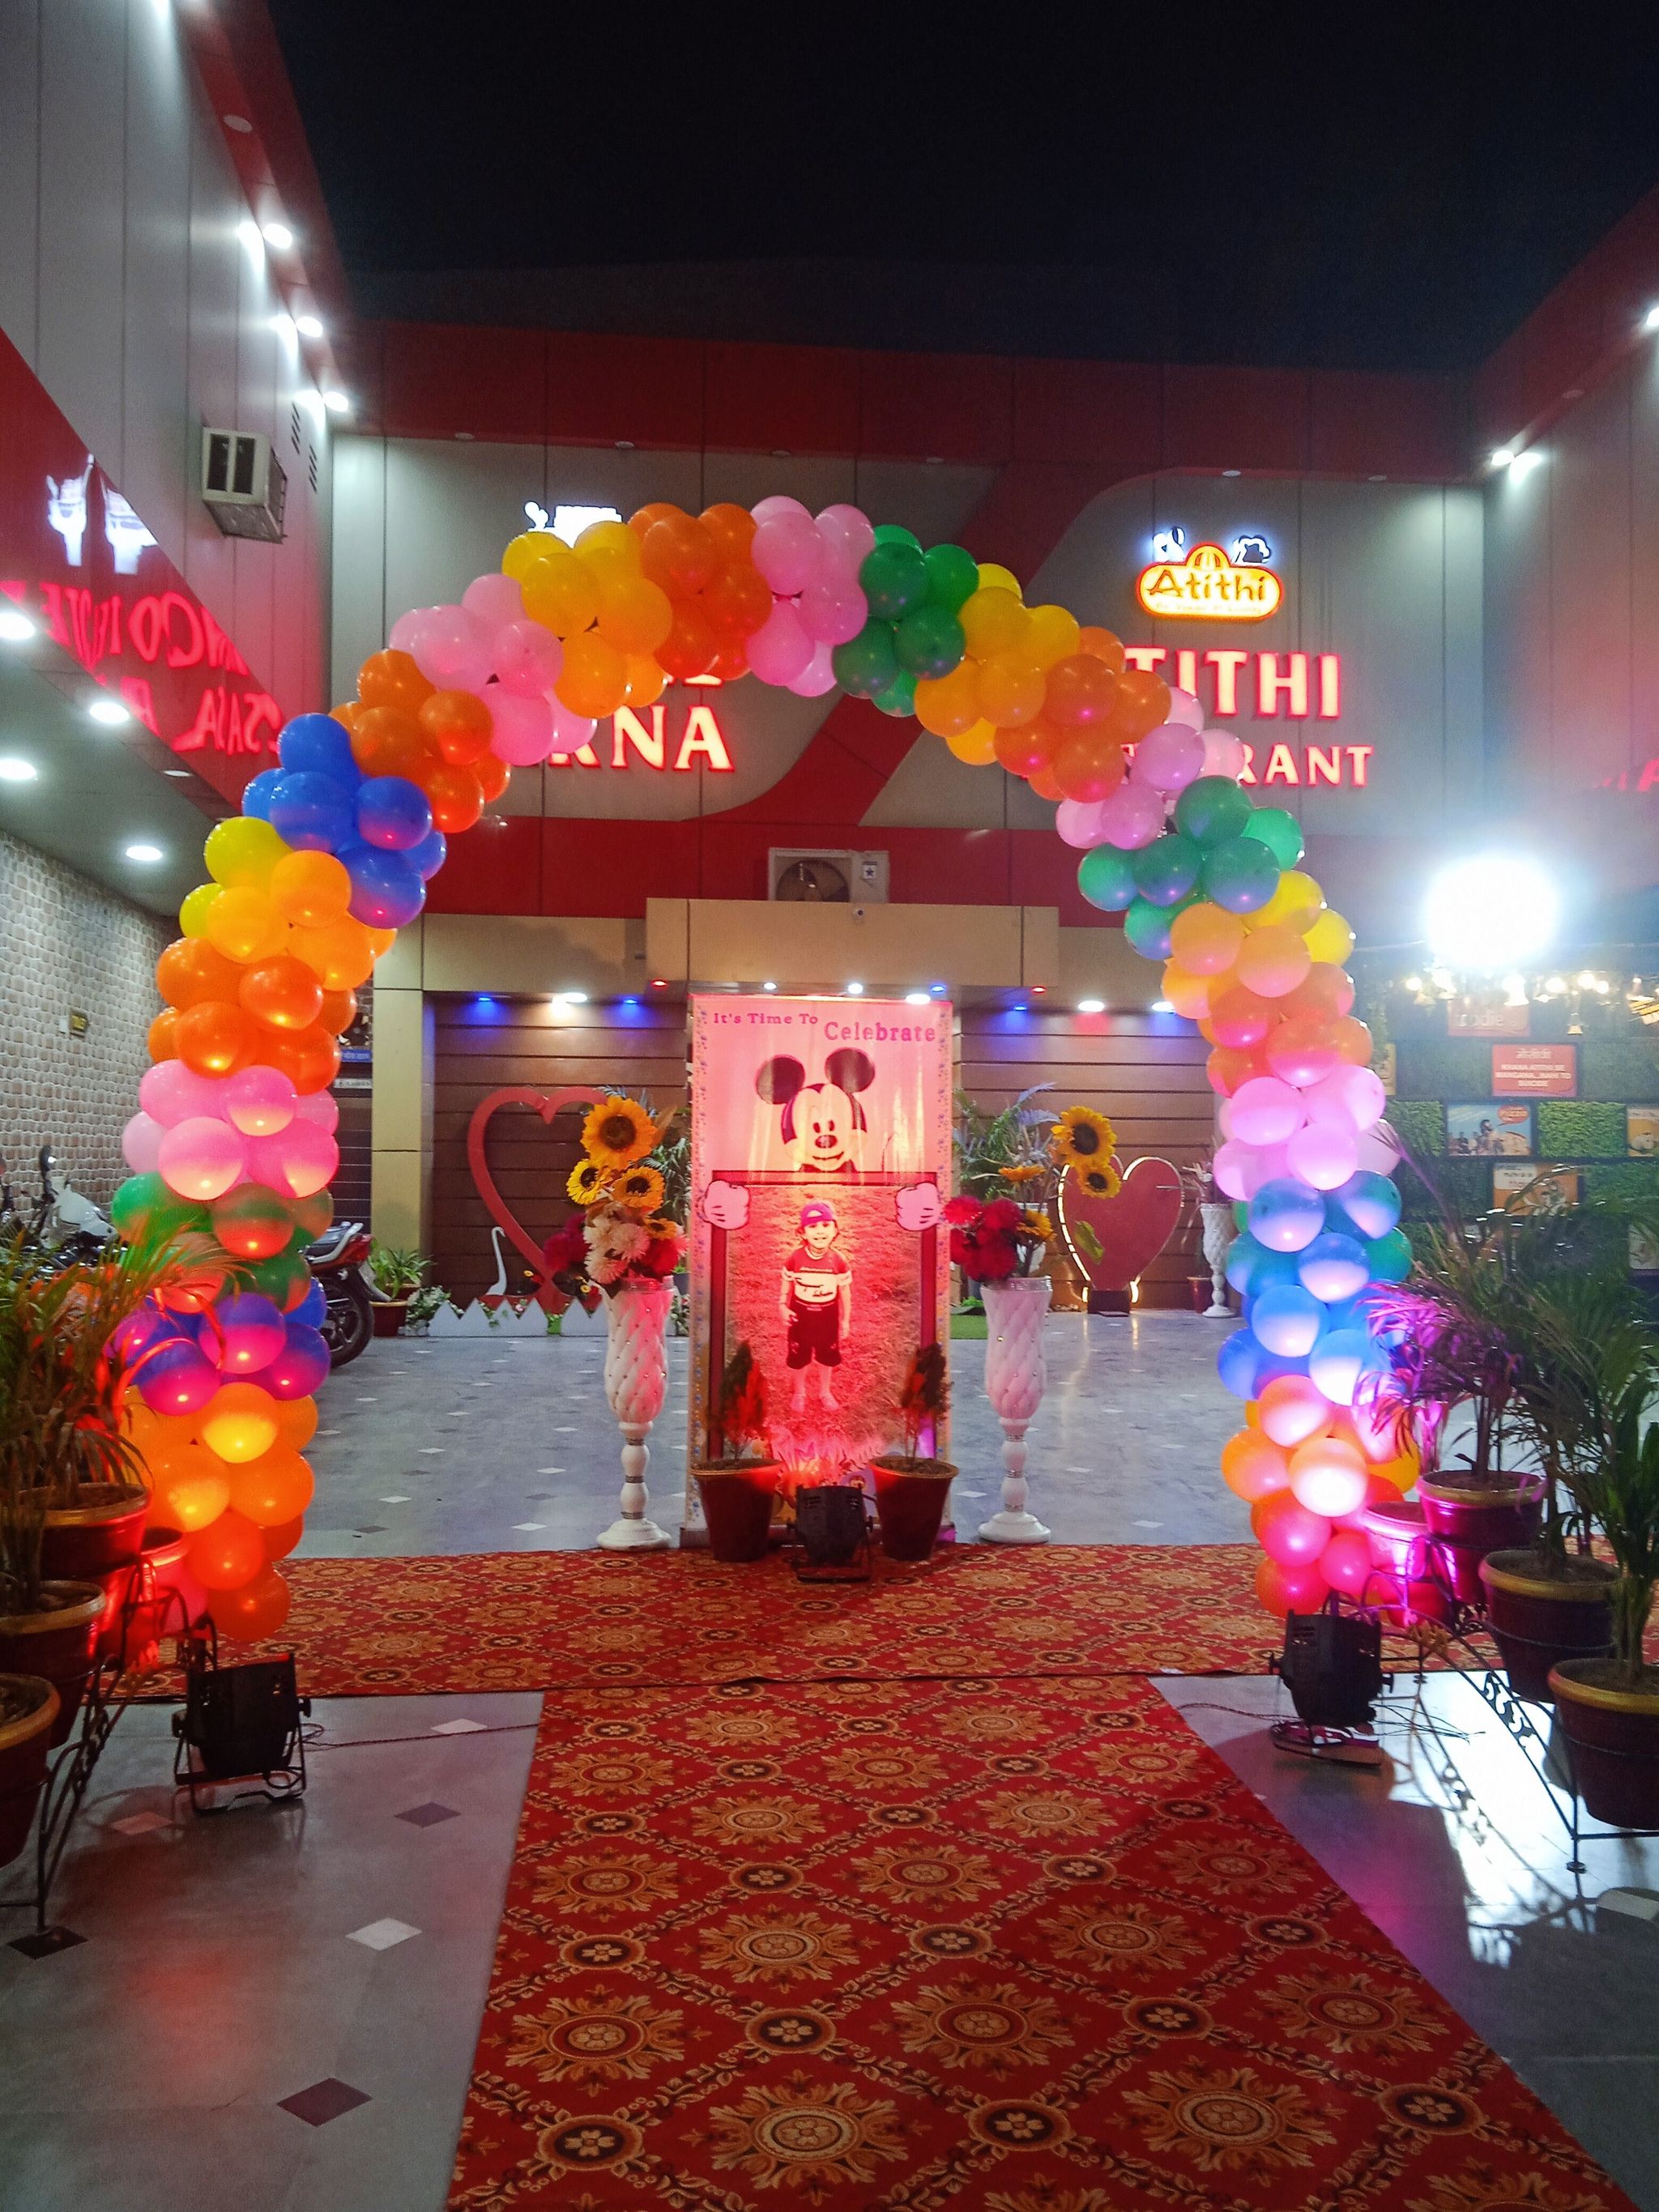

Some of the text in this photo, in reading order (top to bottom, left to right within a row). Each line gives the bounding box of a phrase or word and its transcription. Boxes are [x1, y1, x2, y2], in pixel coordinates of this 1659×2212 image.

[1146, 569, 1265, 601] Atithi
[548, 703, 736, 772] NA
[713, 1012, 819, 1025] It's Time To
[824, 1021, 936, 1042] Celebrate
